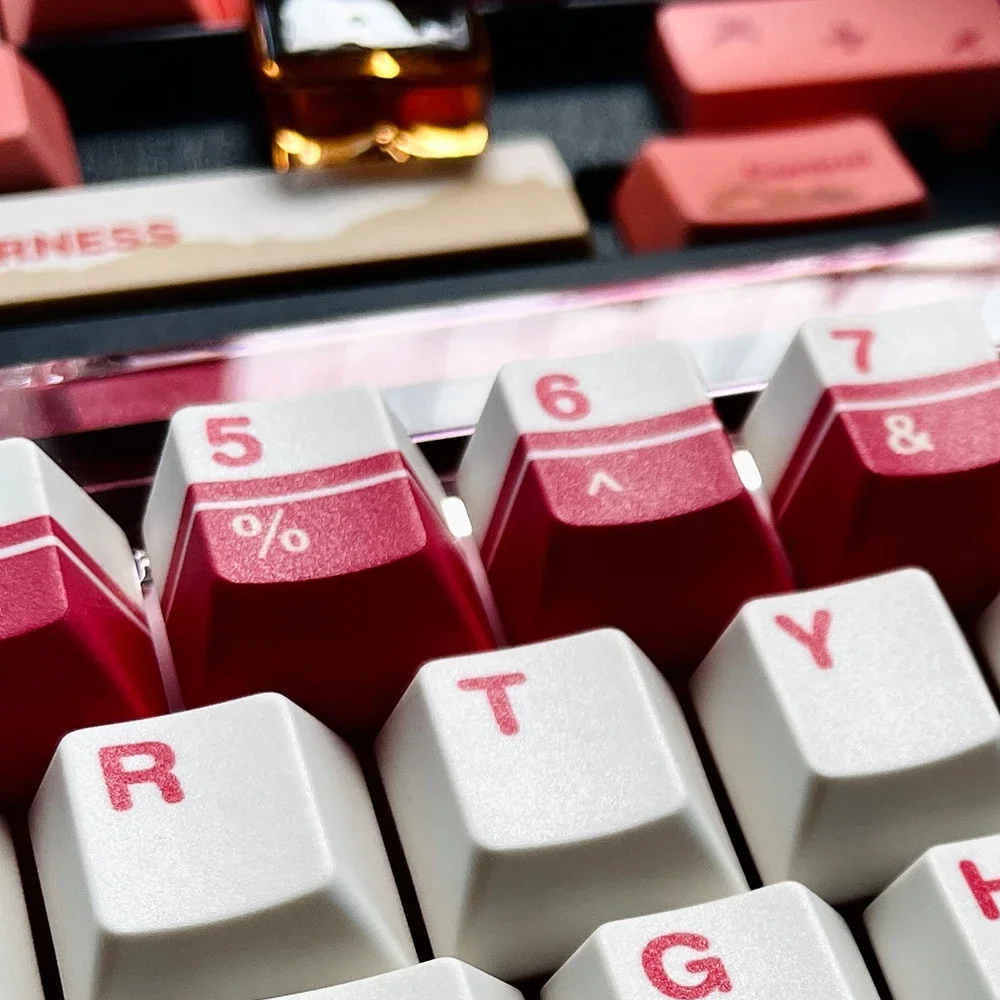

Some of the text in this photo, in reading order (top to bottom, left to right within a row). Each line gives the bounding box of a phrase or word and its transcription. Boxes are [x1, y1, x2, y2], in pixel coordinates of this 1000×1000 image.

[830, 329, 875, 373] 7
[533, 373, 591, 421] 6
[204, 416, 263, 468] 5
[884, 412, 936, 456] &
[230, 506, 312, 560] %
[774, 609, 834, 670] Y
[457, 671, 526, 737] T
[98, 740, 185, 812] R
